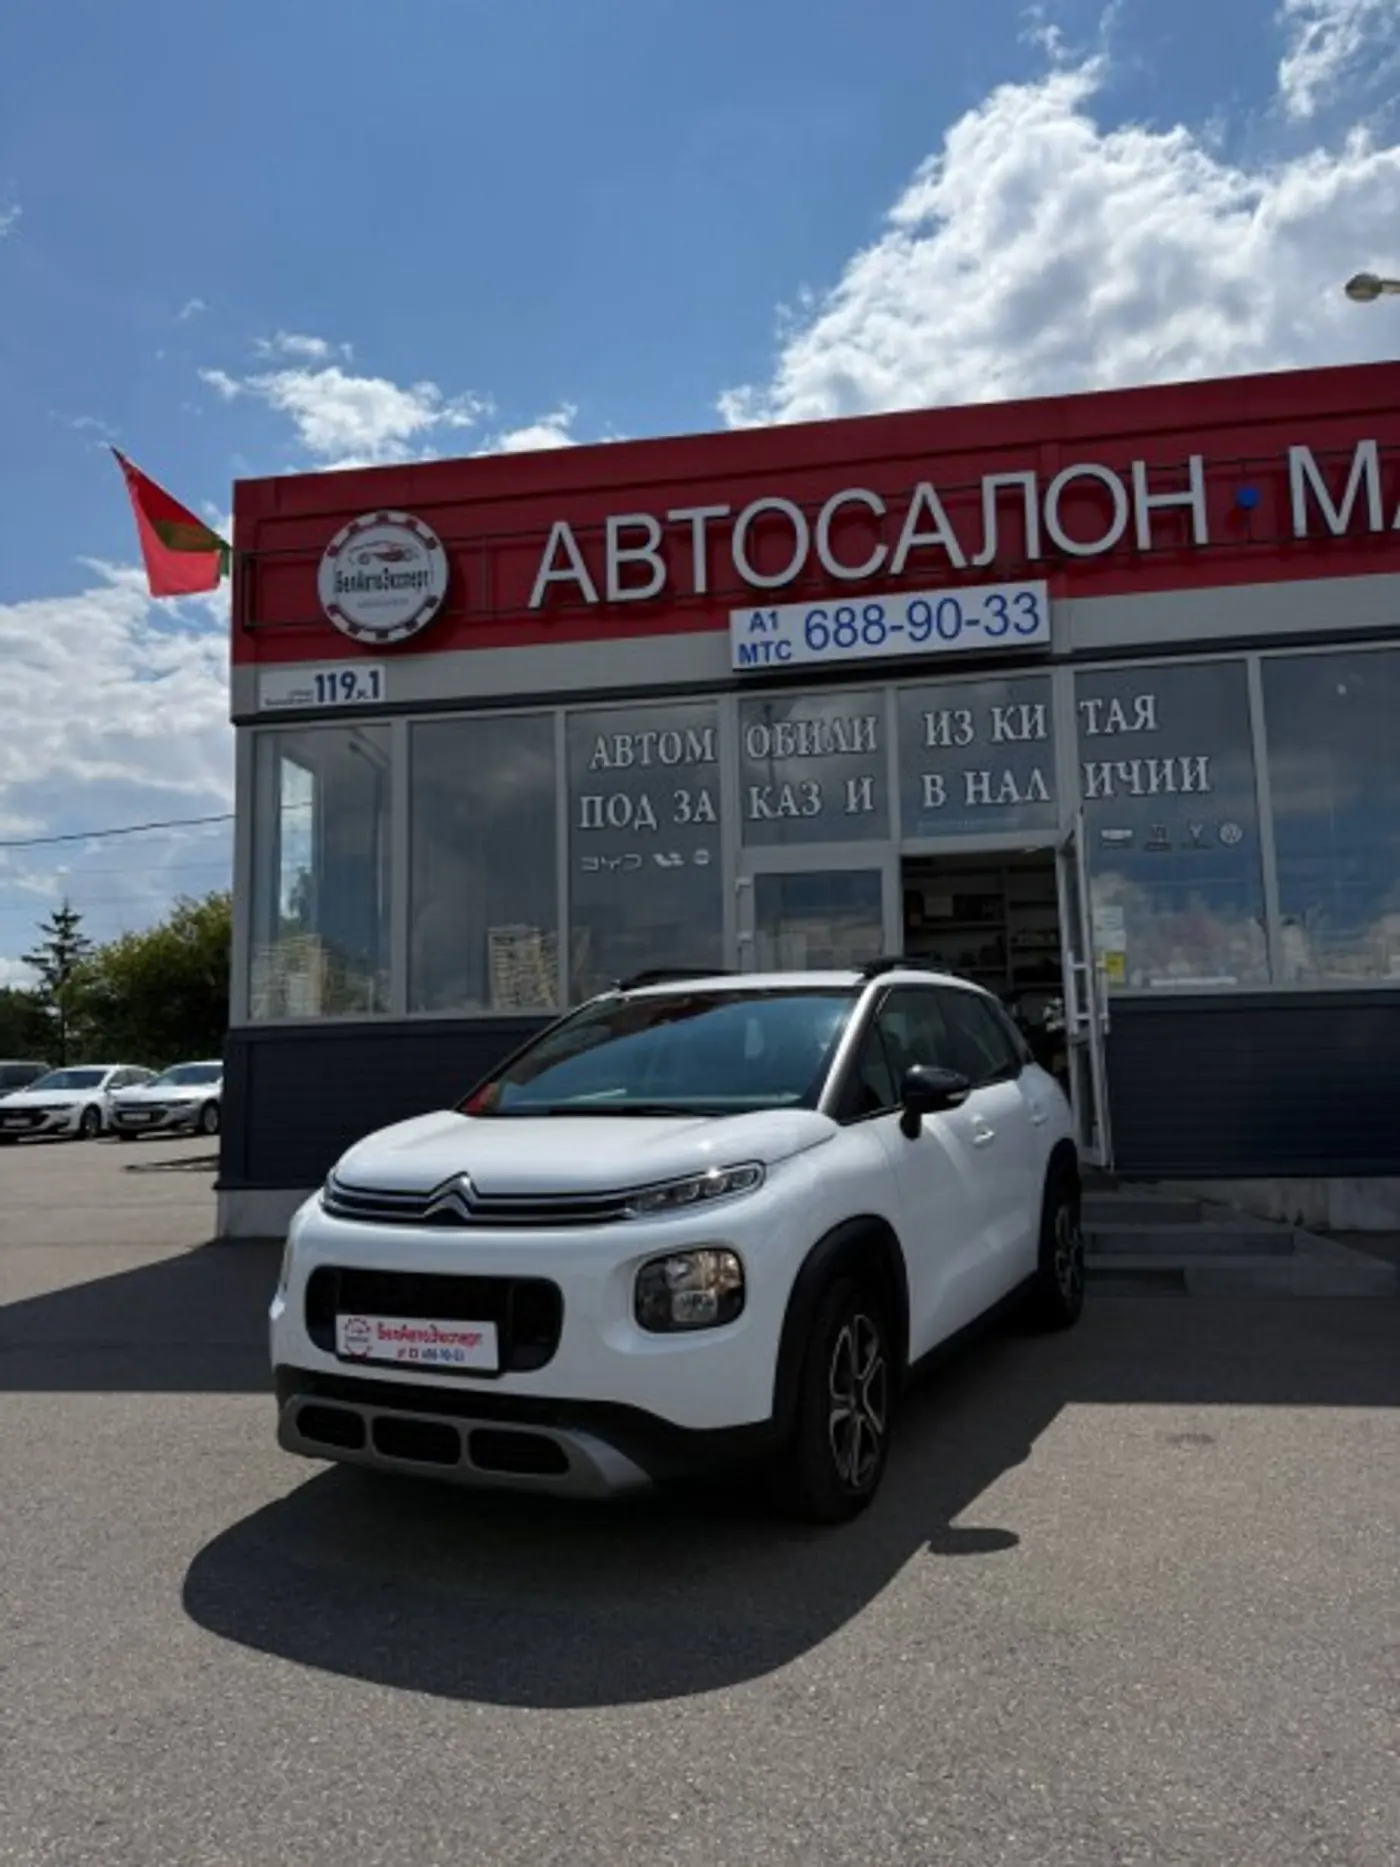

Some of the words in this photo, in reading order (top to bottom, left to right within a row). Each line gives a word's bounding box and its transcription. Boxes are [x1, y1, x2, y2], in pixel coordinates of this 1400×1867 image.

[527, 454, 1209, 608] АВТОСАЛОН
[1289, 438, 1400, 538] М
[738, 640, 792, 665] МТС
[749, 610, 779, 633] A1
[803, 591, 1040, 651] 688-90-33
[590, 728, 716, 770] АВТОМ
[746, 715, 878, 759] ОБИЛИ
[924, 709, 975, 747] ИЗ
[991, 704, 1048, 743] КИ
[1079, 695, 1159, 735] ТАЯ
[579, 793, 658, 831] ПОД
[673, 789, 718, 823] ЗА
[749, 780, 822, 820] КАЗ
[845, 777, 875, 813] И
[922, 774, 947, 807] В
[964, 768, 1051, 806] НАЛ
[1082, 756, 1211, 798] ИЧИИ
